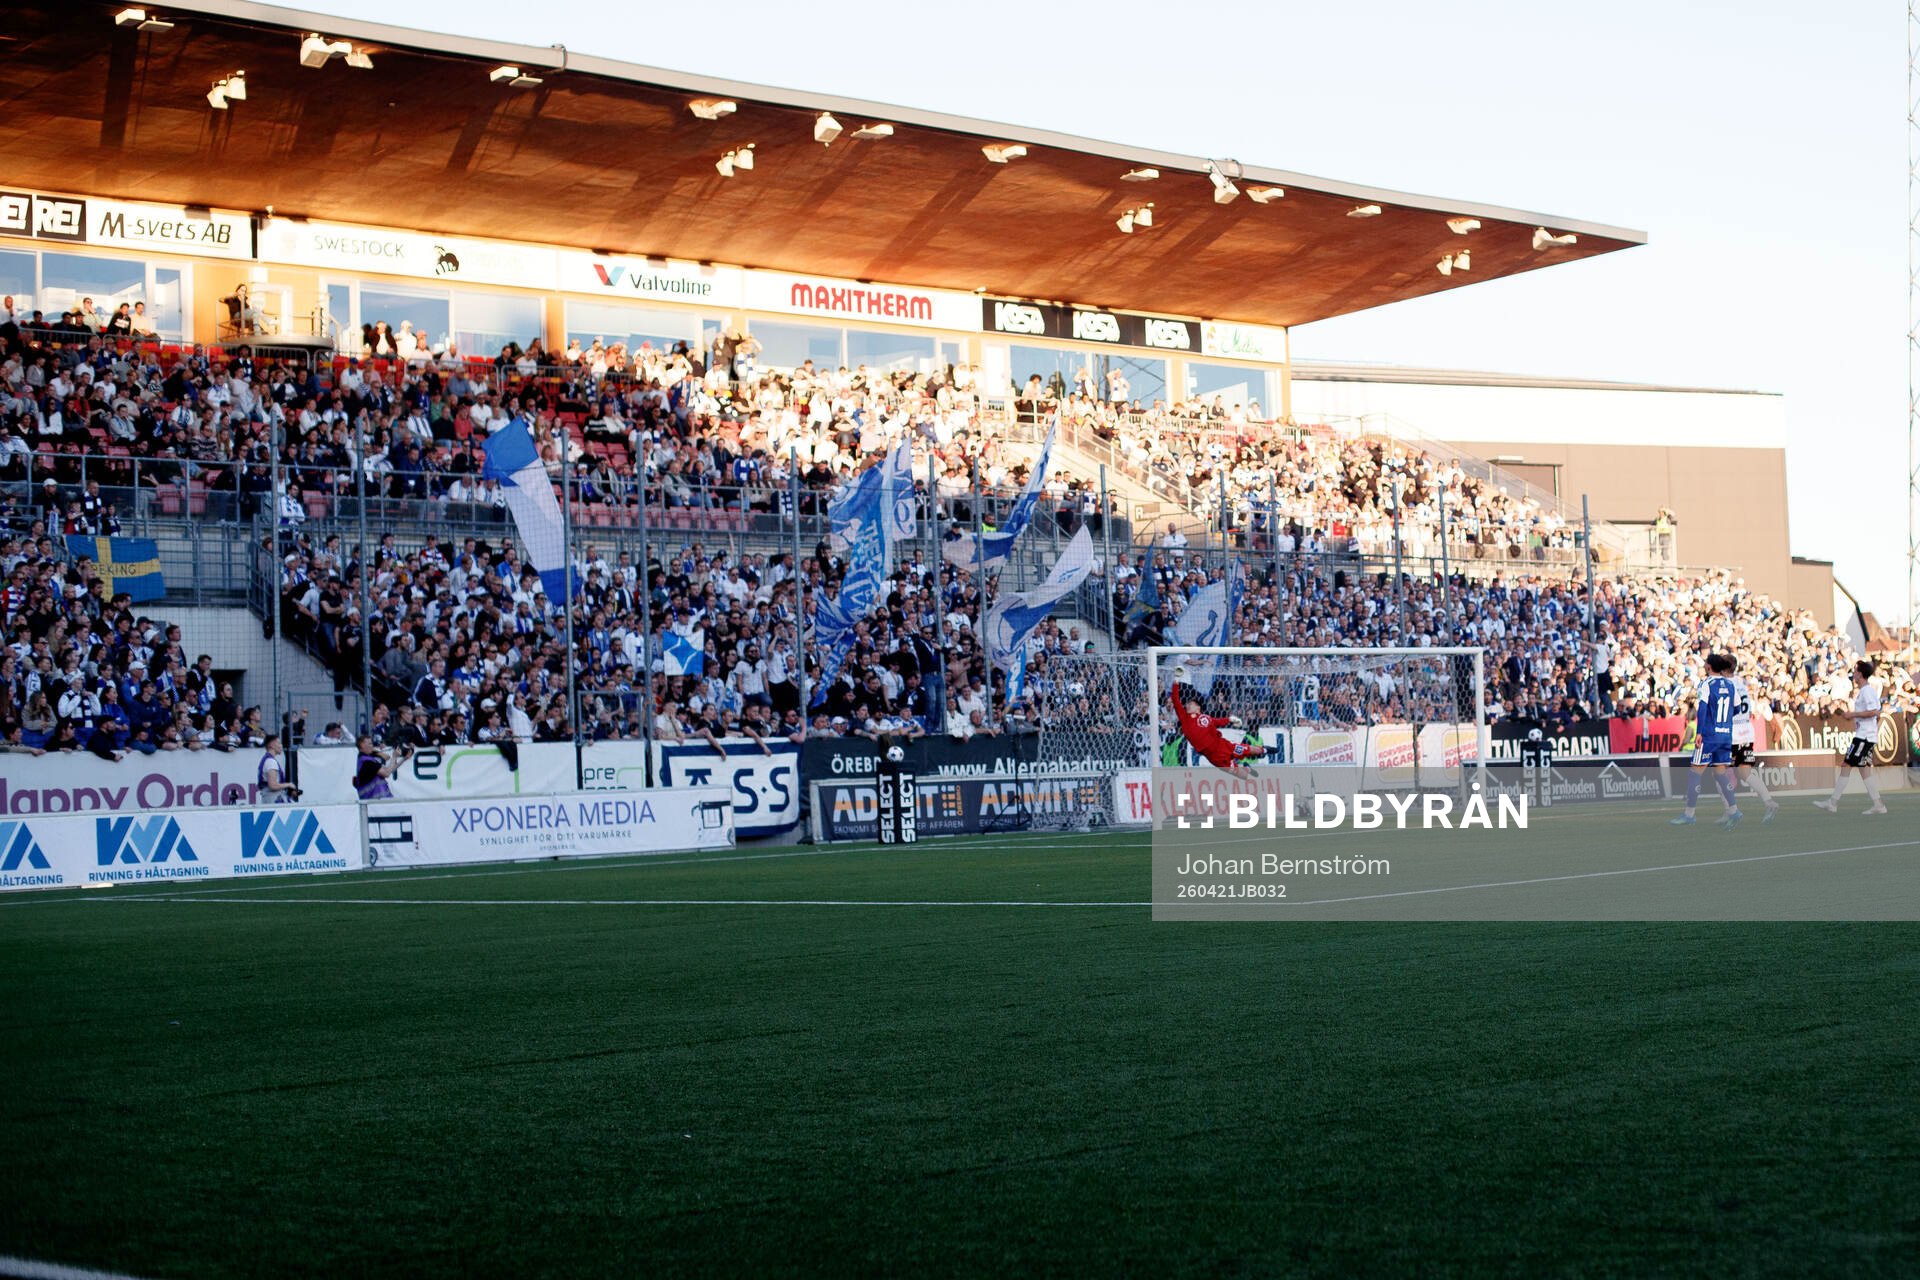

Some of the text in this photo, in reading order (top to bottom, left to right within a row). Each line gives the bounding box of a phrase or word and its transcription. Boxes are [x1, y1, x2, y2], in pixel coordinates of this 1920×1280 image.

[99, 211, 231, 244] M-svets AB
[314, 236, 404, 258] SWESTOCK
[630, 273, 711, 297] Valvoline
[791, 283, 932, 321] MAXITHERM
[1716, 696, 1731, 723] 11
[584, 767, 615, 783] pre
[1523, 750, 1536, 807] SELECT
[1540, 749, 1551, 807] SELECT
[1606, 776, 1660, 793] Kornboden
[451, 800, 656, 833] XPONERA MEDIA
[880, 773, 895, 844] SELECT
[899, 772, 916, 843] SELECT
[480, 835, 529, 845] SYNLIGHET
[578, 830, 632, 840] VARUMÄRKE
[89, 866, 209, 882] RIVNING & HÅLTAGNING
[234, 858, 347, 875] RIVNING & HÅLTAGNING
